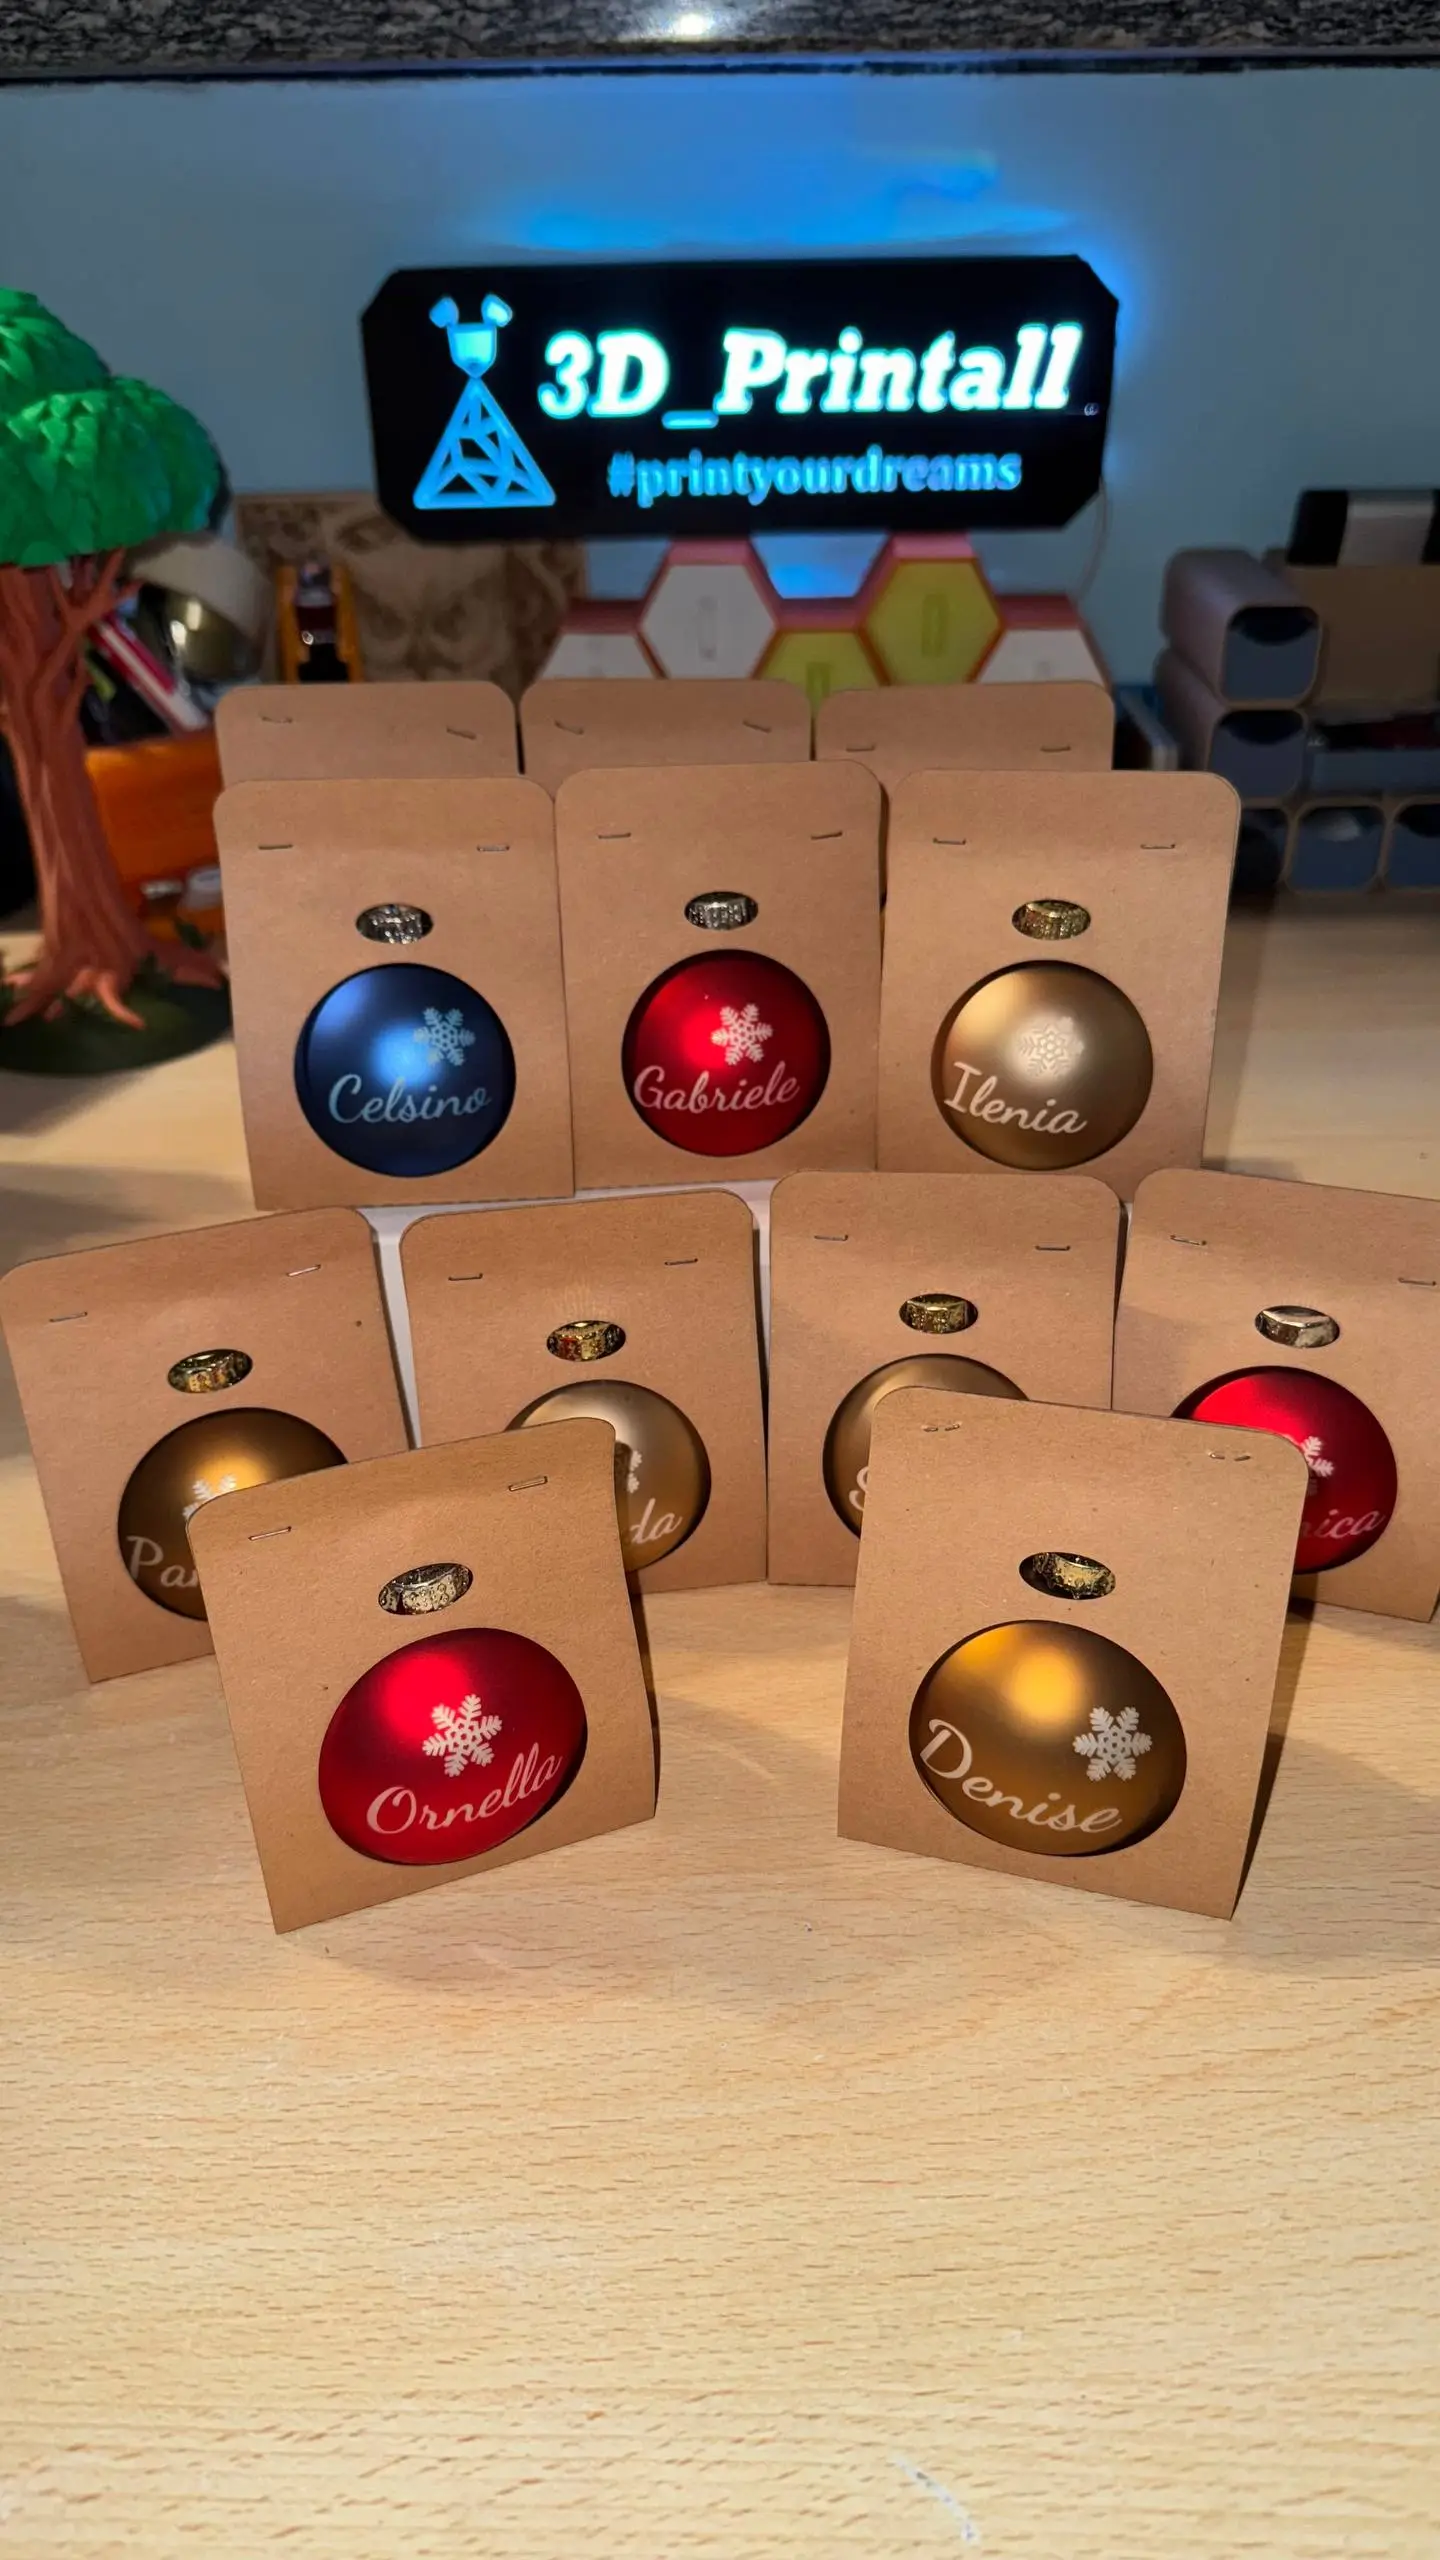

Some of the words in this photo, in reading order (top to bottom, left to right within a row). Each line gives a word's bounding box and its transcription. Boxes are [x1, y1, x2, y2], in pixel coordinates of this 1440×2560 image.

[538, 322, 1083, 428] 3D_Printall
[607, 446, 1022, 508] #printyourdreams
[328, 1074, 491, 1123] Celsino
[633, 1060, 801, 1114] Gabriele
[944, 1060, 1087, 1134] Ilenia
[366, 1742, 563, 1835] Ornella
[919, 1718, 1123, 1833] Denise
